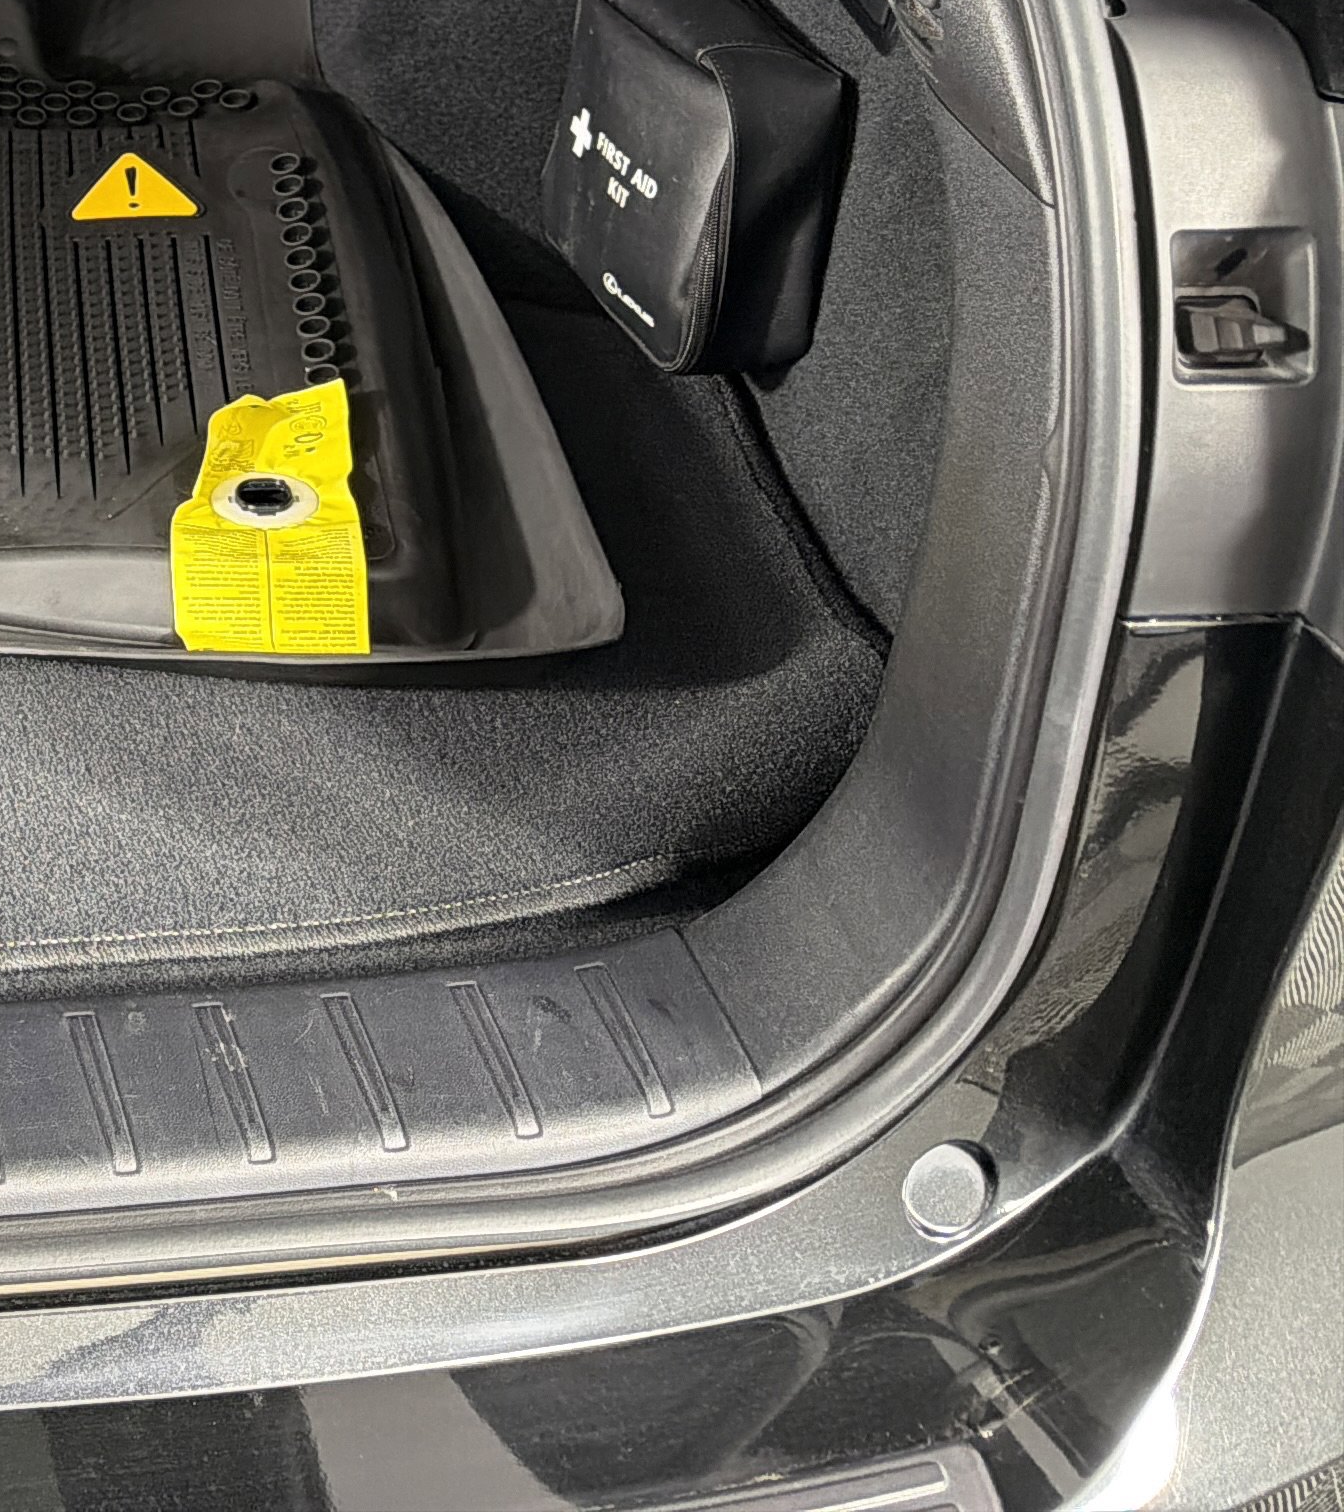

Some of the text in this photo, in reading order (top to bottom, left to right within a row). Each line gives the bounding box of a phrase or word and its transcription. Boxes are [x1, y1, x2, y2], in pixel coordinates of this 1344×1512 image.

[596, 131, 658, 199] FIRST AID
[607, 176, 630, 209] KIT
